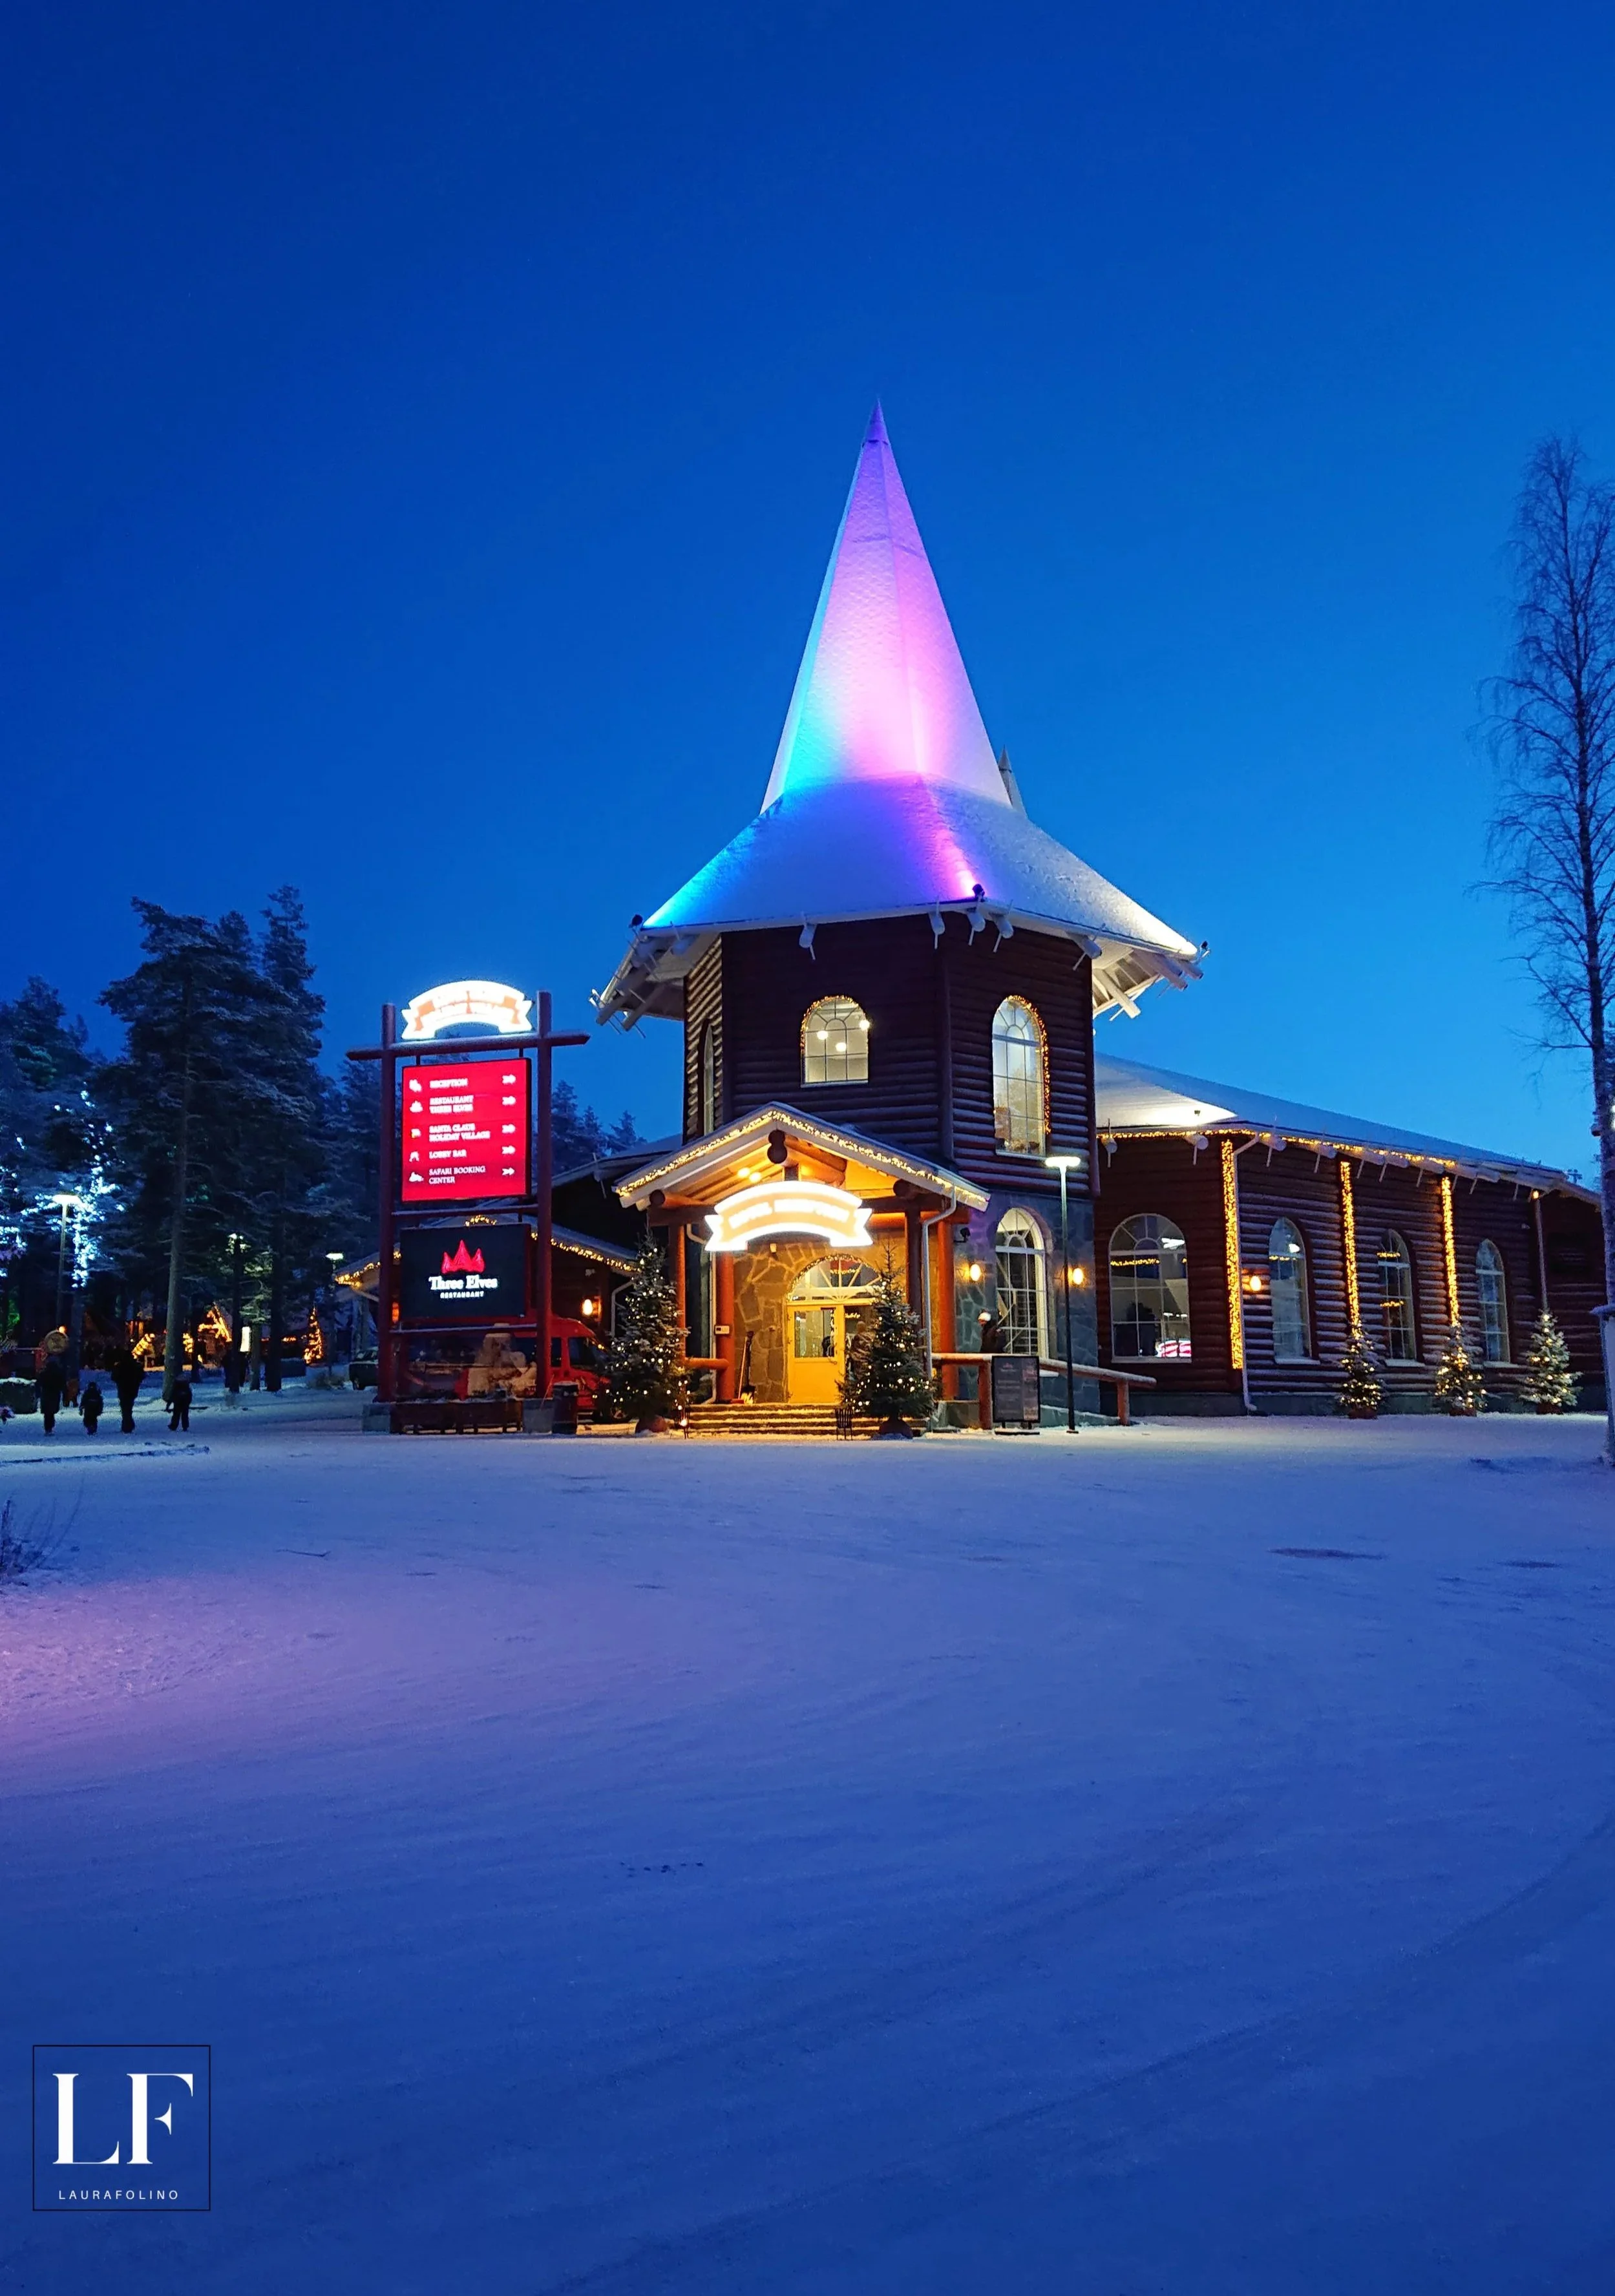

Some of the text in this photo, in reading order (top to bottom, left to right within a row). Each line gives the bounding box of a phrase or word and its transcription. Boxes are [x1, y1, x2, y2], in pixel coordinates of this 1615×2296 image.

[454, 1166, 485, 1174] BOOKING
[428, 1274, 498, 1290] Three Elves
